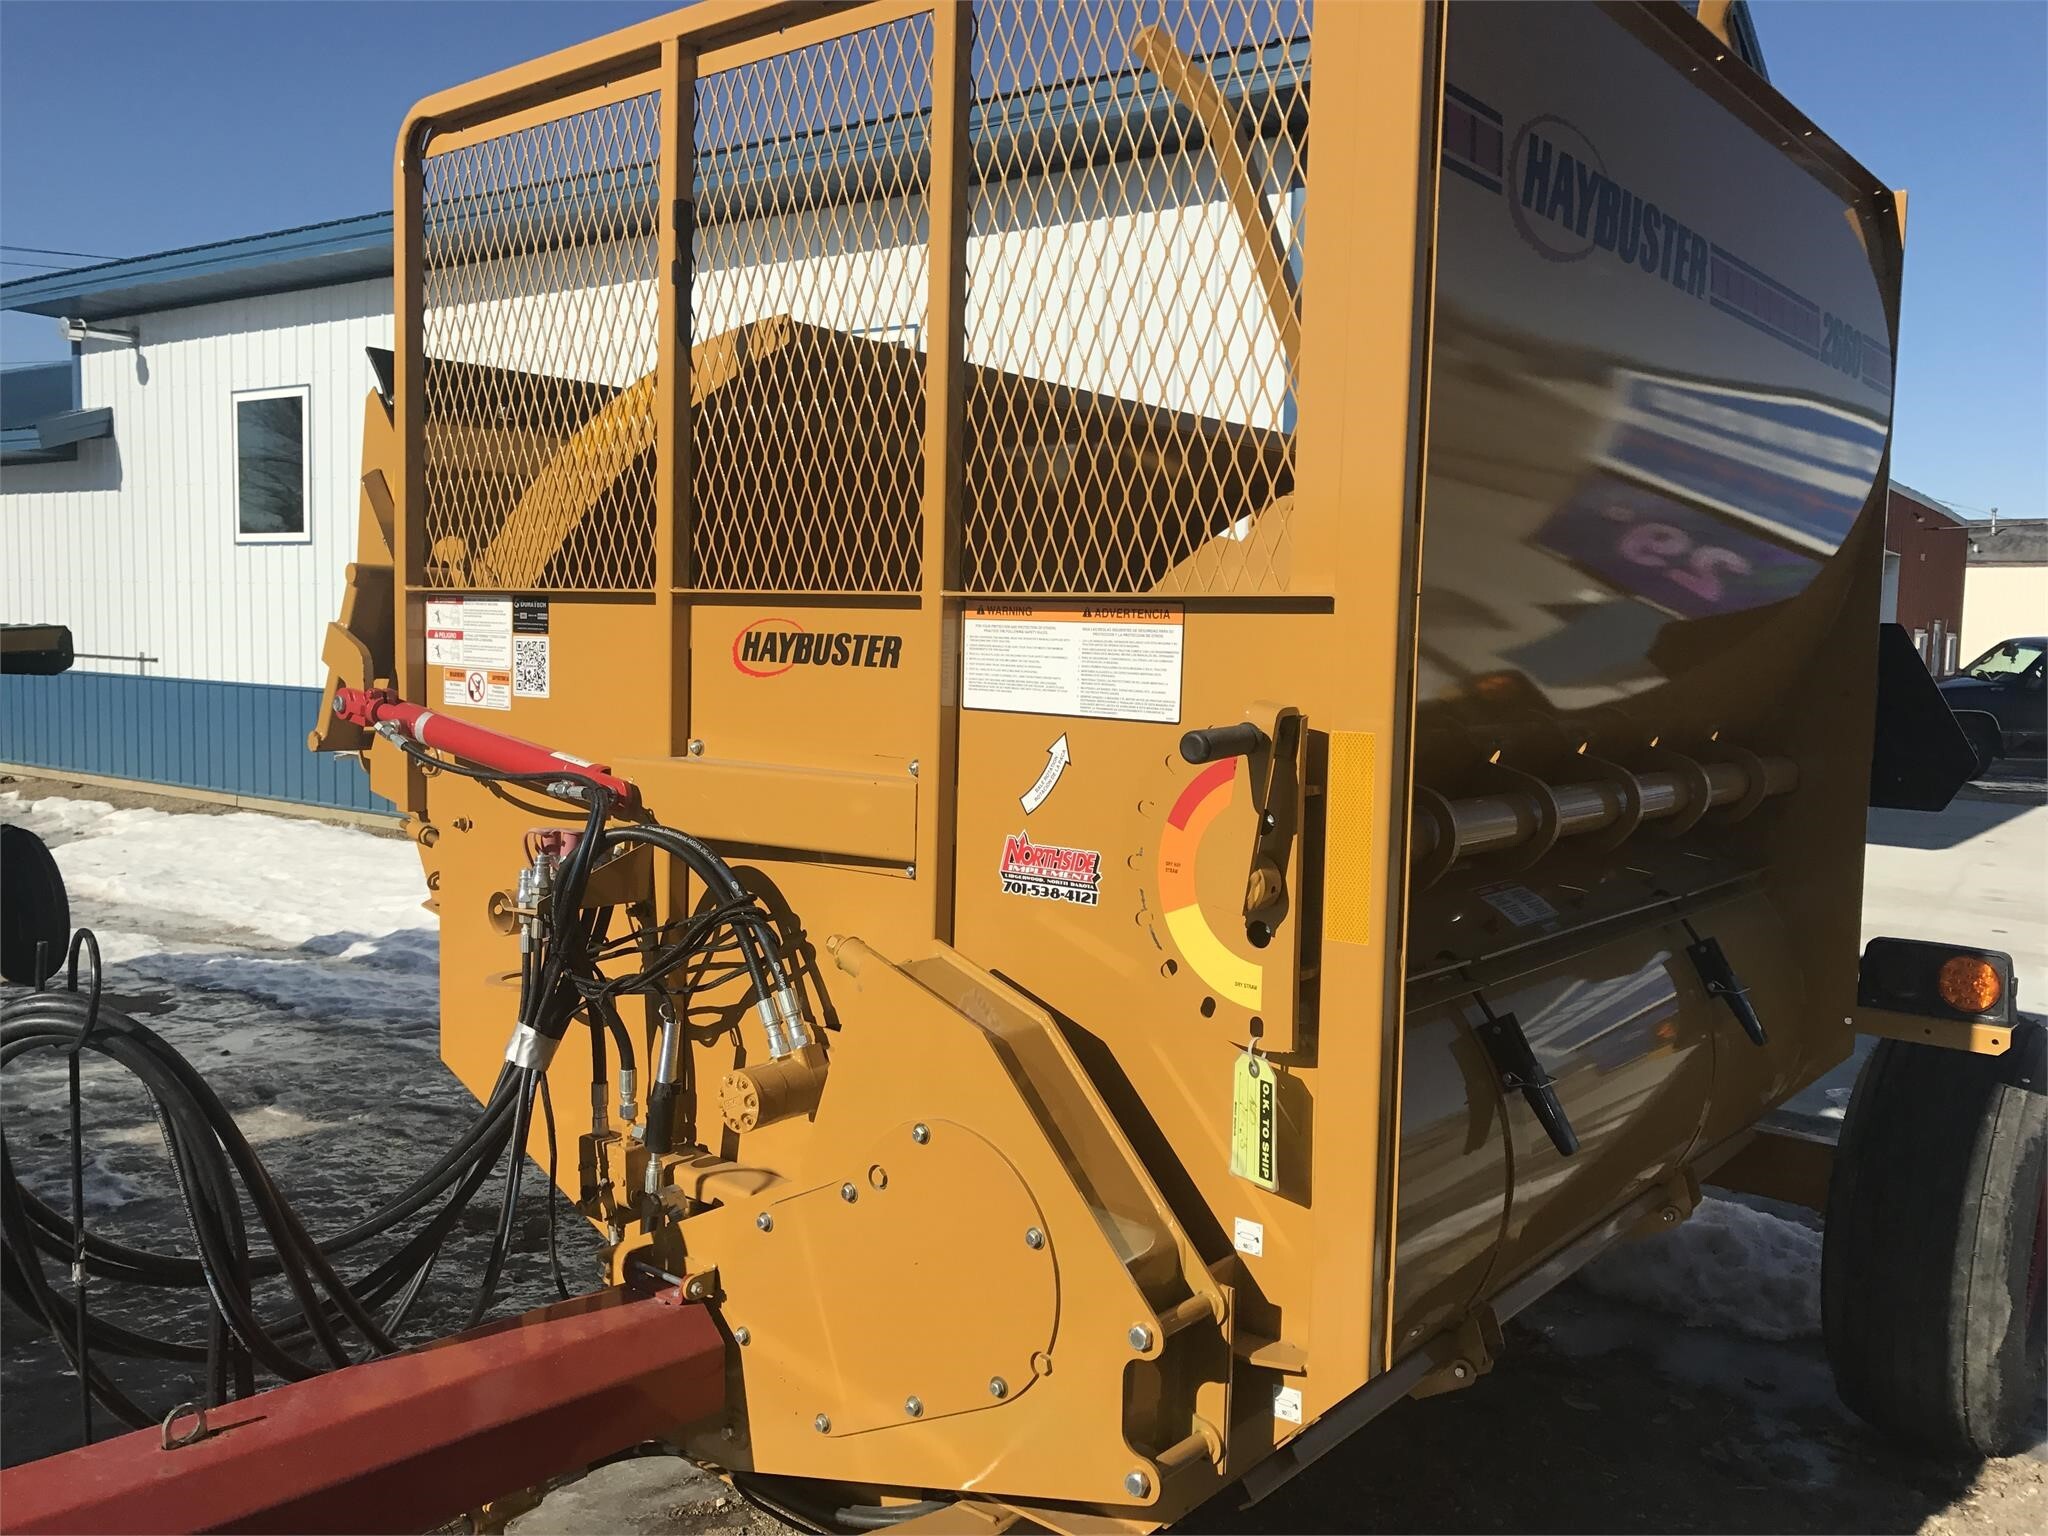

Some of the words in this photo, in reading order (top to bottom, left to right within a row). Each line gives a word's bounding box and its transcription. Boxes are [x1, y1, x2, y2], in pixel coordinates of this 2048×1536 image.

[1521, 132, 1708, 300] HAYBUSTER
[986, 605, 1033, 617] WARNING
[1094, 607, 1171, 620] ADVERTENCIA
[741, 631, 903, 669] HAYBUSTER
[1044, 756, 1058, 781] ROTATION
[1002, 835, 1098, 874] NORTHSIDE
[1008, 864, 1095, 882] IMPLEMENT
[1047, 878, 1069, 886] NORTH
[1070, 882, 1094, 890] DAKOTA
[1003, 880, 1098, 905] 701-538-4121
[1262, 1083, 1270, 1114] O.K.
[1262, 1119, 1270, 1139] TO
[1261, 1142, 1270, 1179] SHIP
